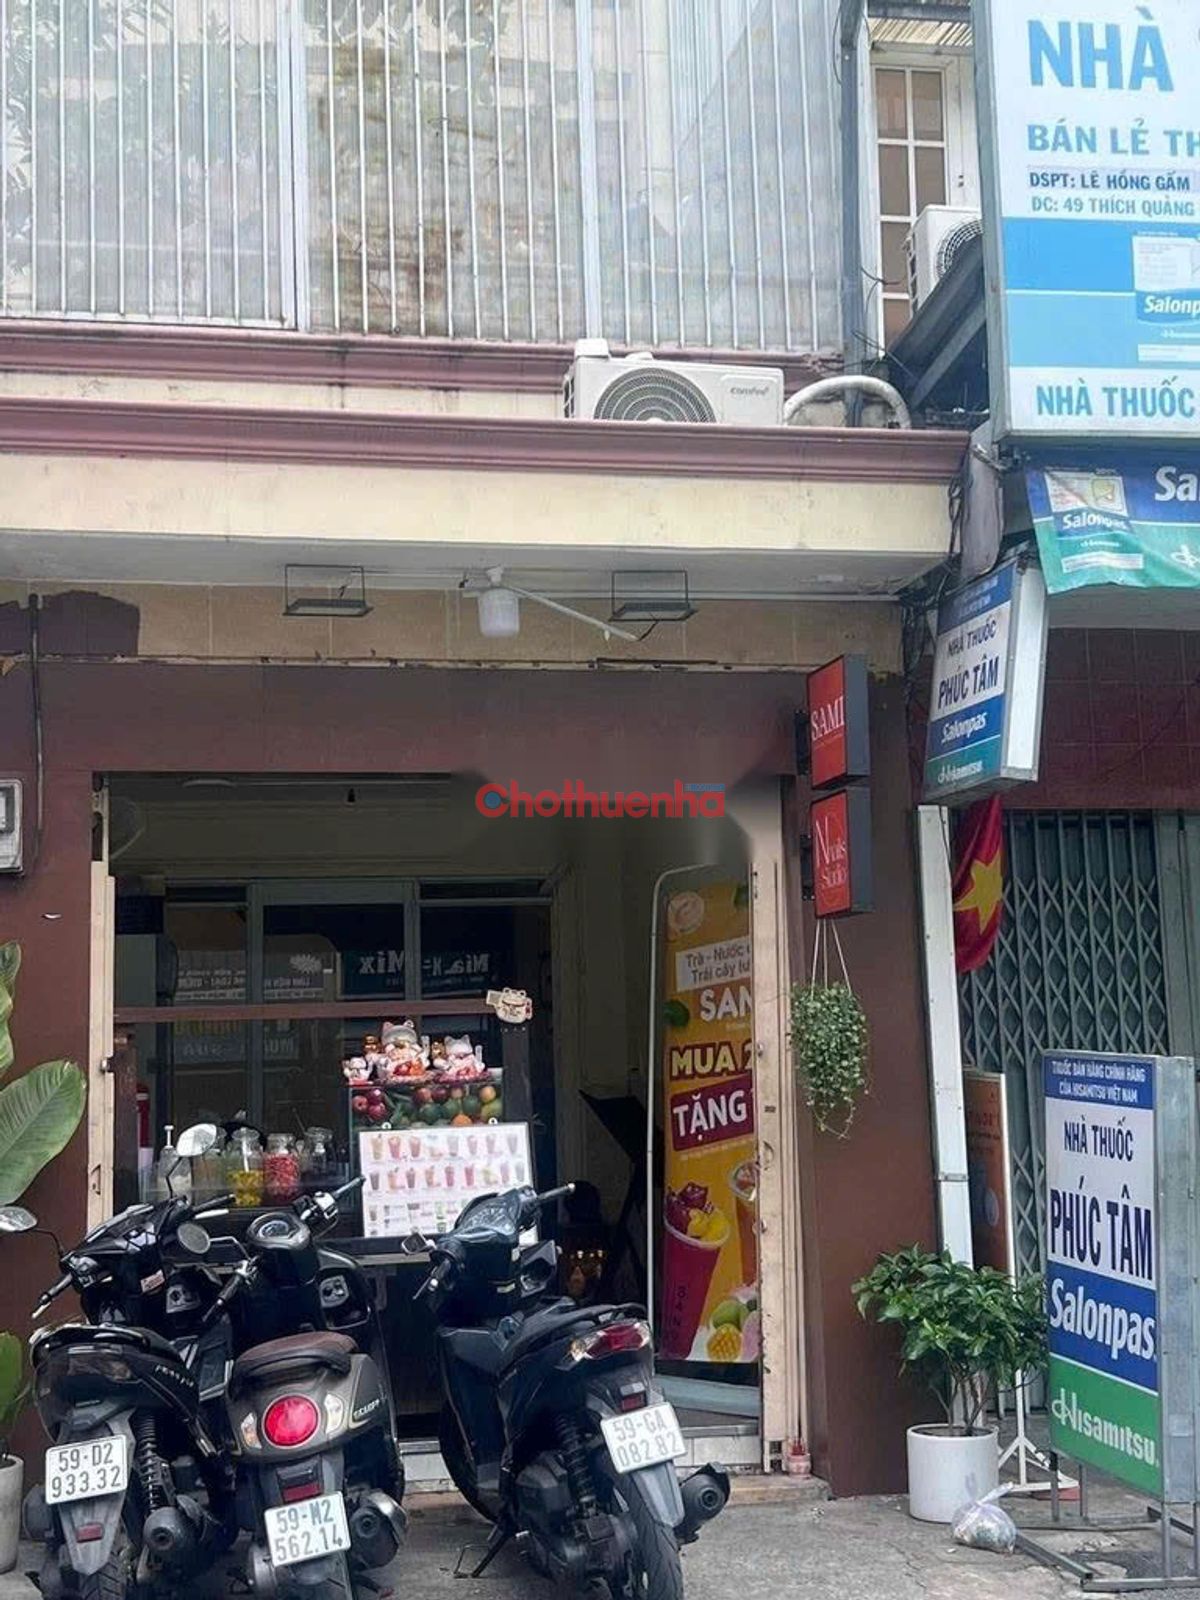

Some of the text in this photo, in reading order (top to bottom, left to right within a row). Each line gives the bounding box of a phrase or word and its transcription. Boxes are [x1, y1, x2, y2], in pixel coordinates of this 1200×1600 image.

[1027, 5, 1175, 92] NHÀ
[1026, 118, 1097, 153] BÁN
[1109, 117, 1150, 156] LẺ
[1029, 172, 1076, 188] DSPT:
[1081, 171, 1100, 189] LÊ
[1063, 197, 1084, 213] 49
[1088, 195, 1136, 214] THÍCH
[1036, 376, 1195, 418] NHÀ THUỐC
[938, 654, 999, 710] PHÚC TÂM
[811, 696, 845, 742] SAMI
[671, 1044, 736, 1077] MUA
[673, 1090, 747, 1141] TẶNG
[1122, 1087, 1138, 1103] NAM
[1064, 1115, 1133, 1161] NHÀ THUỐC
[1050, 1175, 1153, 1281] PHÚC TÂM
[1050, 1277, 1156, 1360] Salonpas
[51, 1465, 121, 1499] 933.32
[273, 1524, 344, 1562] 562.14
